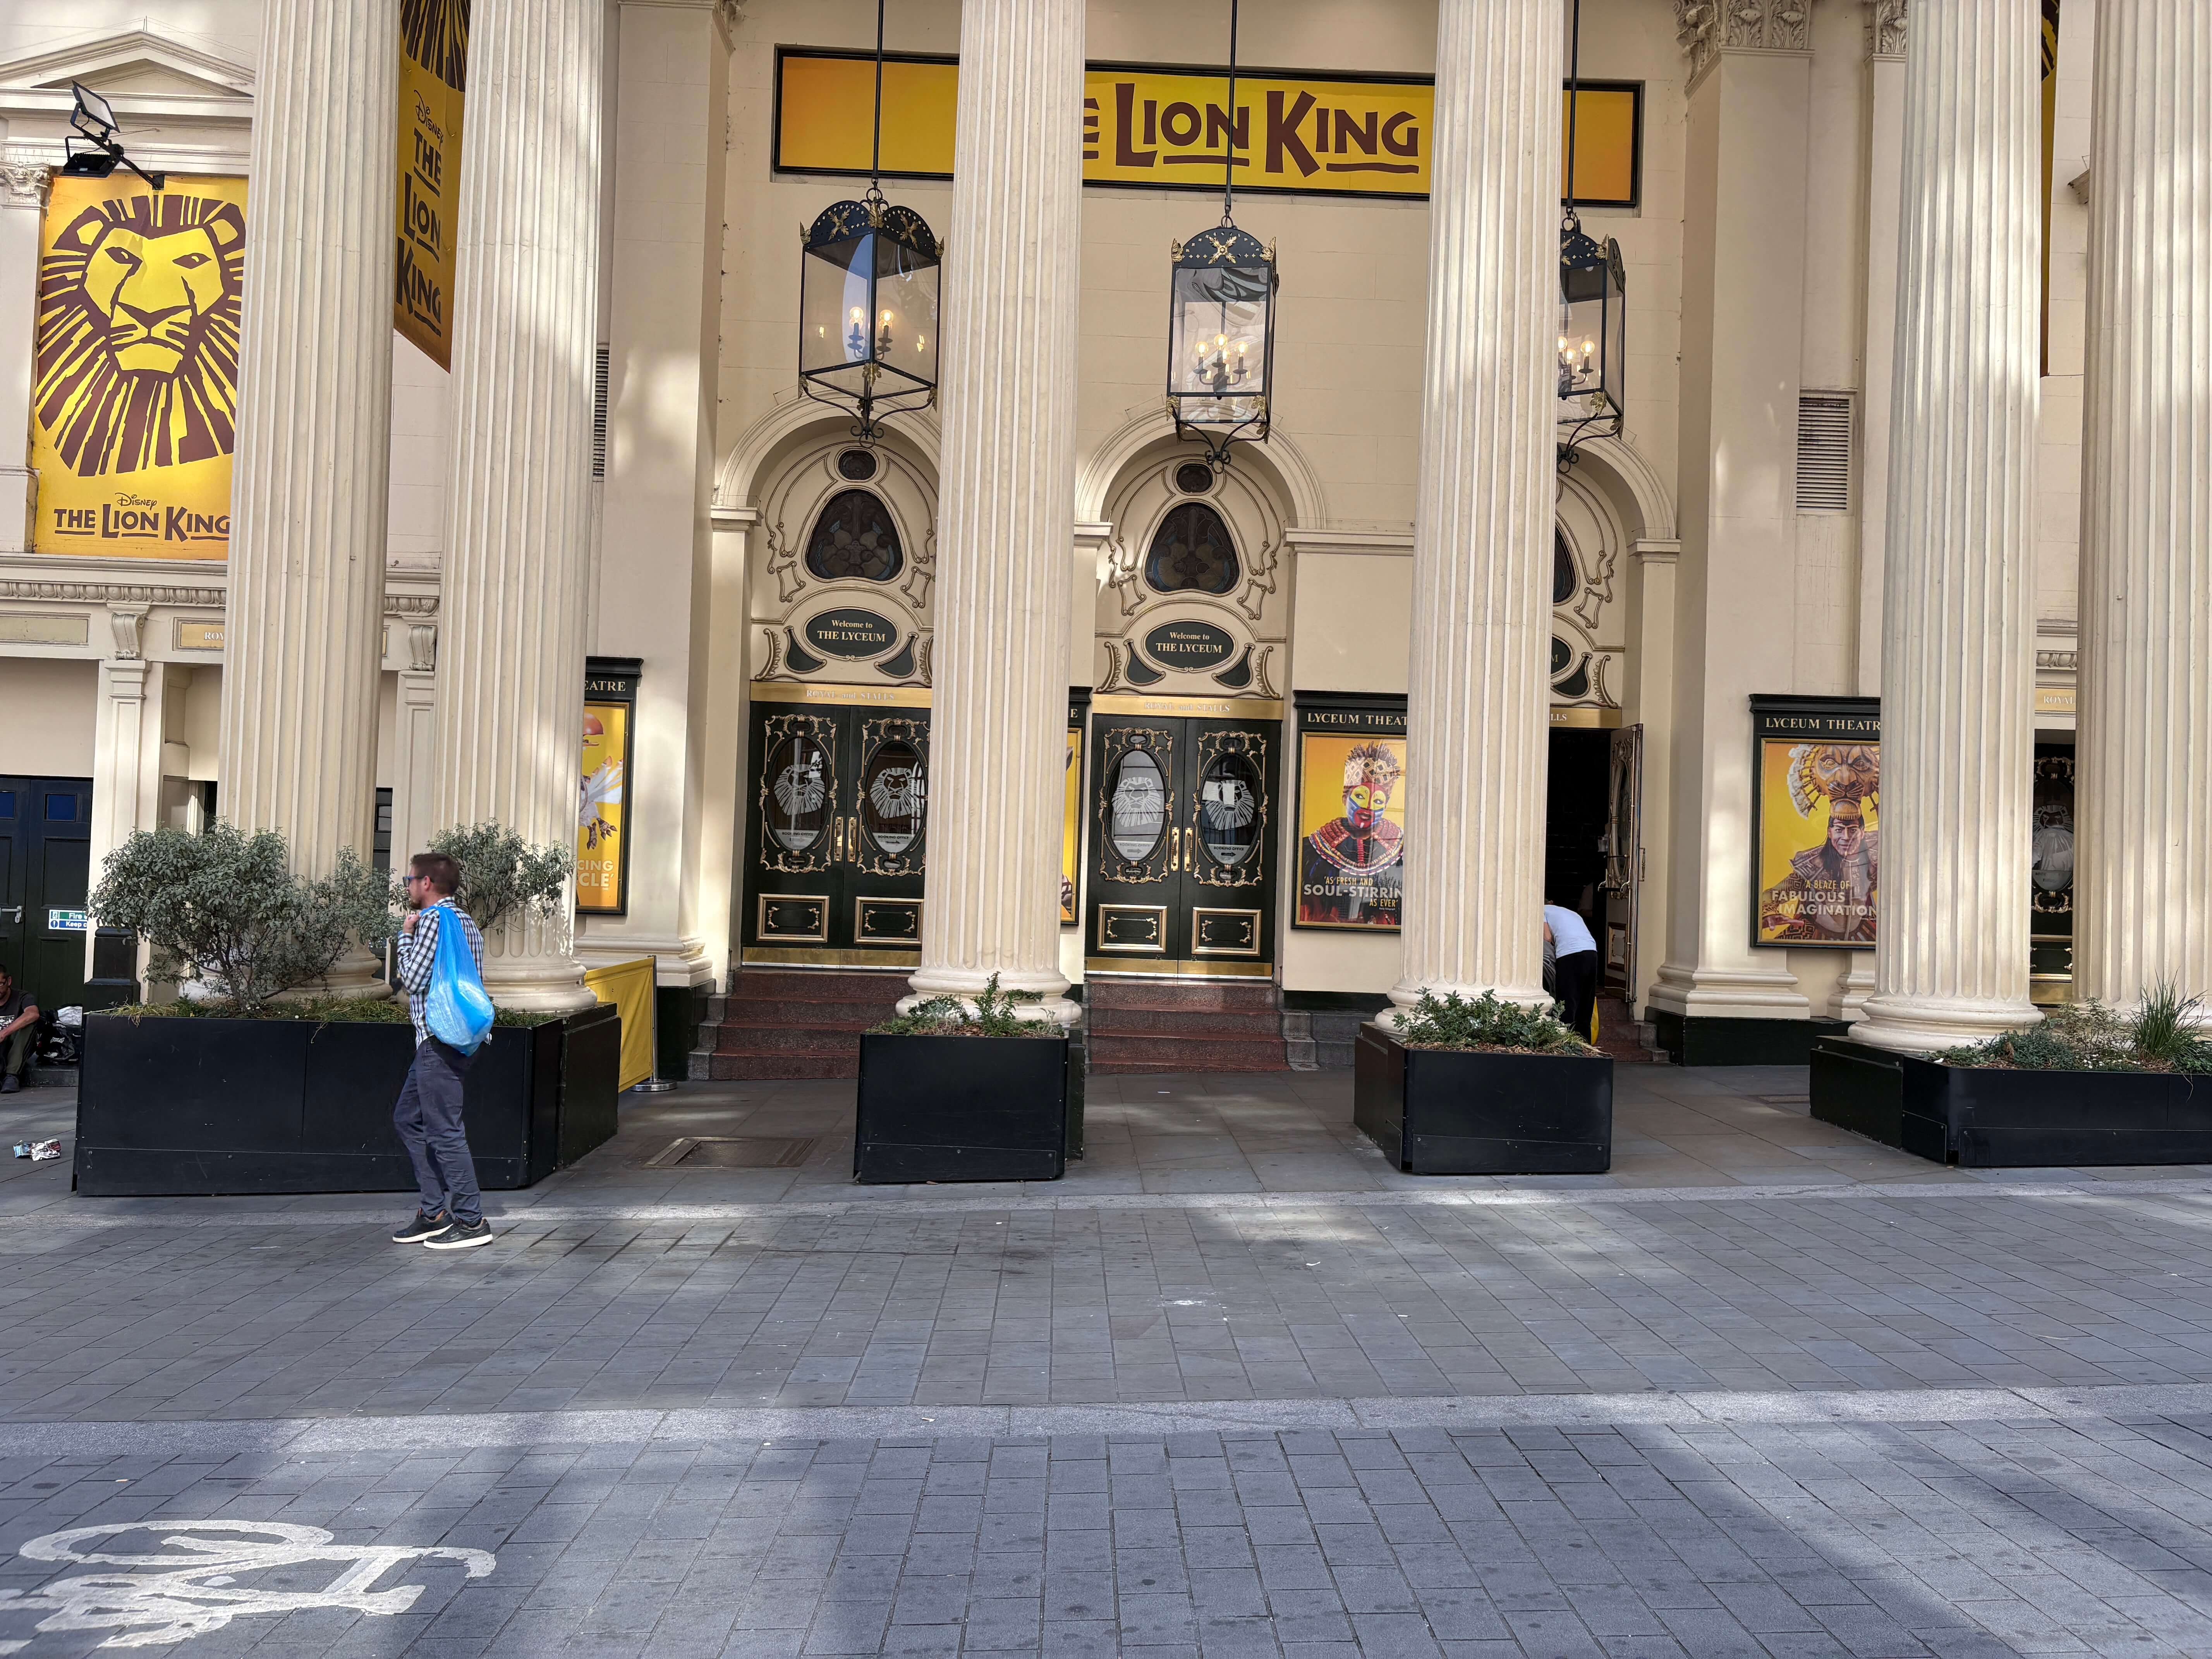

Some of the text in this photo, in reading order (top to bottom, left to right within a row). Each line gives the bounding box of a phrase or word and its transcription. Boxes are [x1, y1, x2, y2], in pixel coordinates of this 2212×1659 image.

[1115, 83, 1250, 167] LION
[1265, 90, 1419, 177] KING
[414, 127, 441, 187] THE
[53, 508, 96, 529] THE
[101, 503, 159, 538] LION
[831, 620, 864, 628] Welcome
[817, 630, 886, 642] THE LYCEUM
[1170, 632, 1201, 640] Welcome
[1156, 643, 1222, 653] THE LYCEUM
[807, 690, 835, 698] ROYAL
[1145, 701, 1173, 710] ROYAL
[1197, 704, 1230, 712] STALLS
[1307, 713, 1359, 724] LYCEUM
[1766, 718, 1820, 729] LYCEUM
[1336, 877, 1356, 885] FRESH
[1359, 878, 1373, 886] AND
[1814, 879, 1837, 890] BLAZE
[1840, 880, 1850, 890] OF
[1772, 890, 1845, 903] FABULOUS
